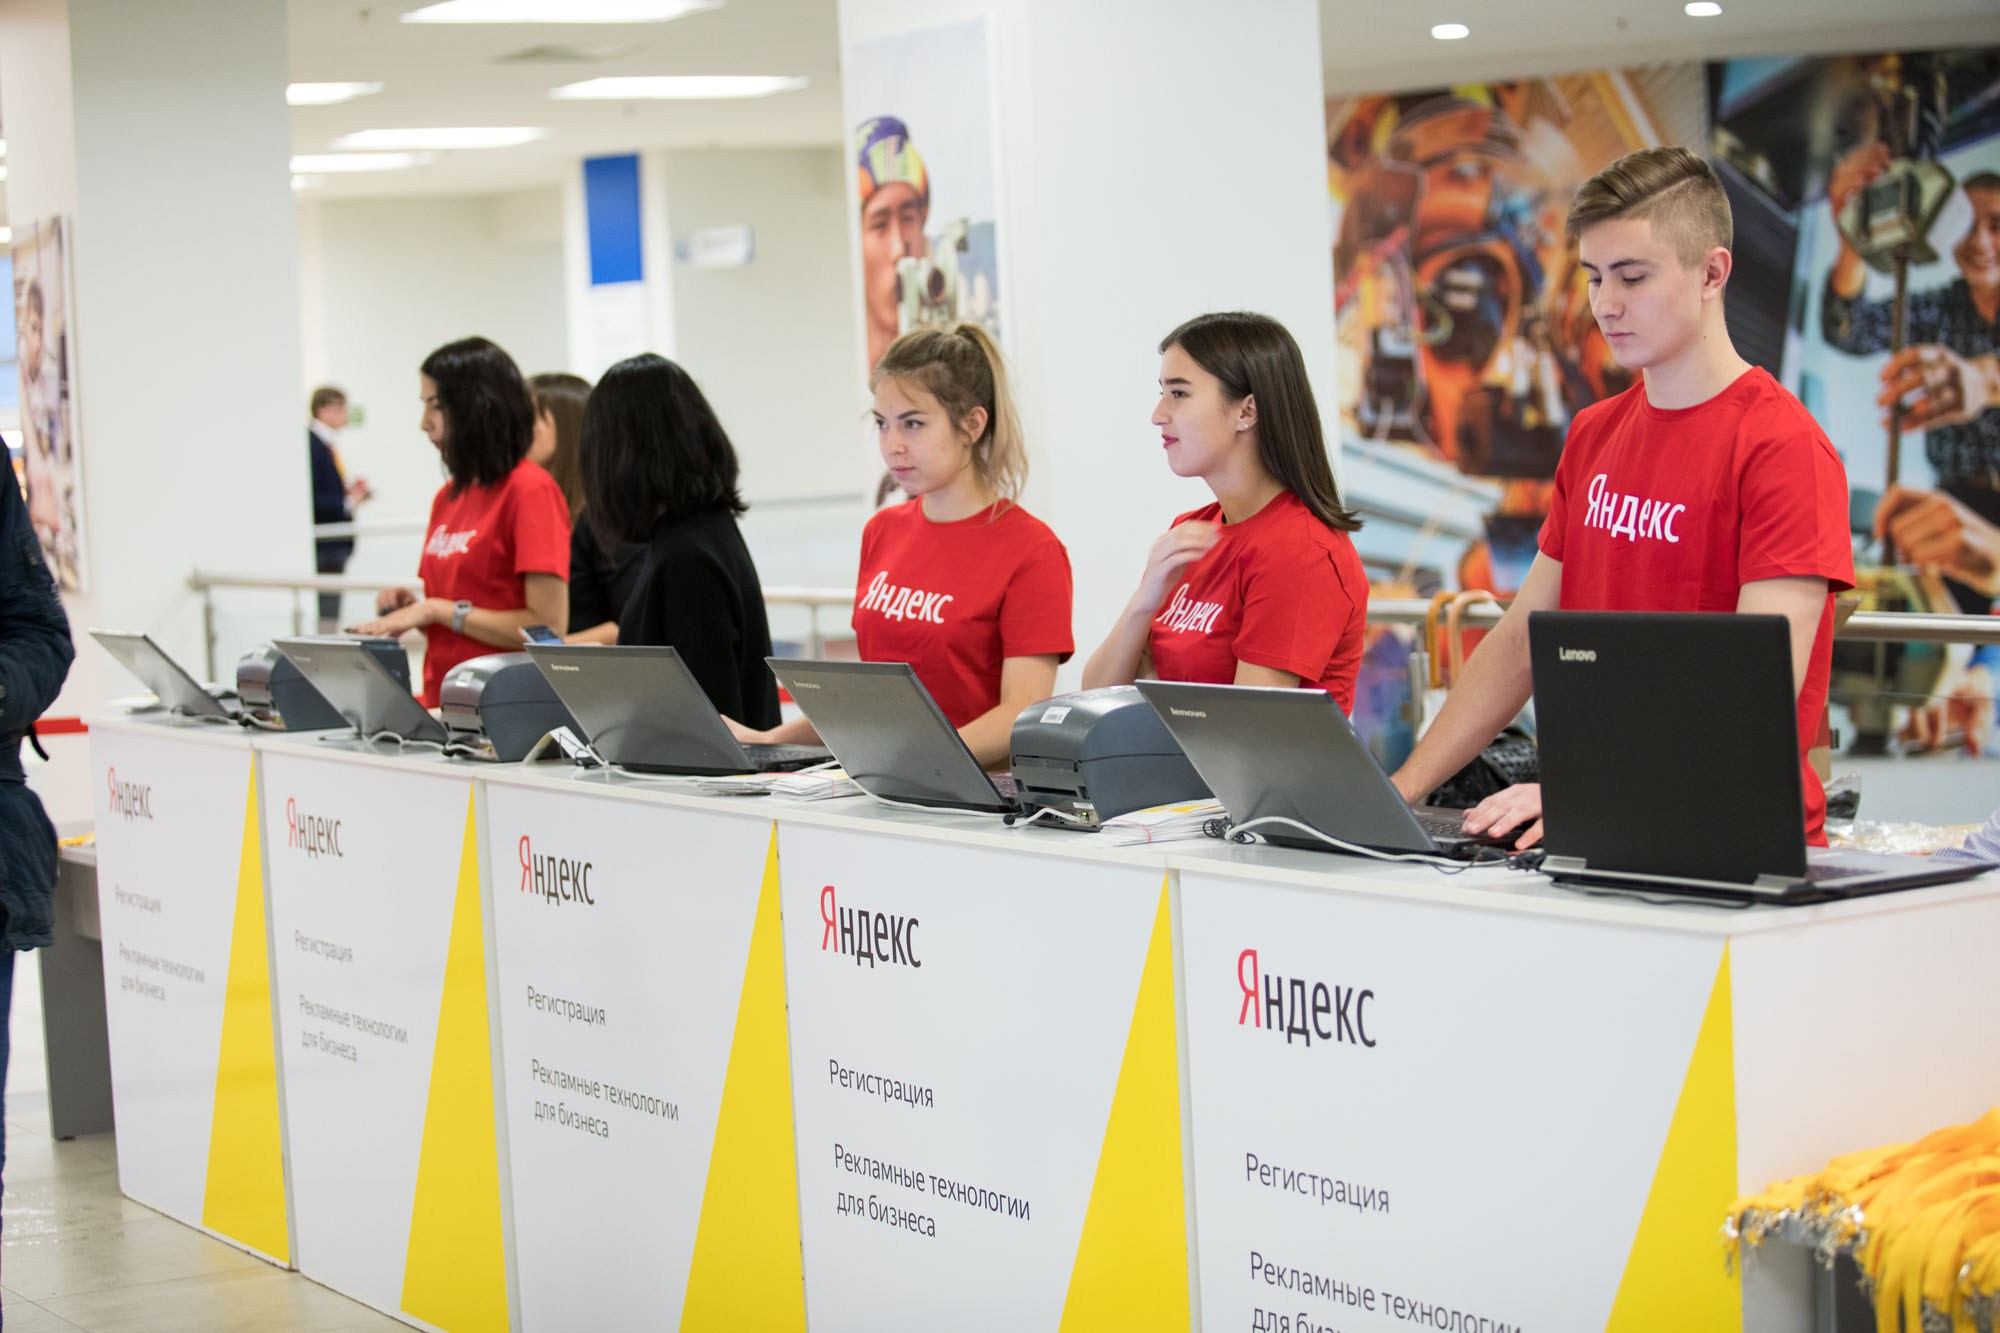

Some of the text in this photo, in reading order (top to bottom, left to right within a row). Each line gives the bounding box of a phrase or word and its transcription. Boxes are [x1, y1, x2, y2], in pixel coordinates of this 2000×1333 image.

[1583, 473, 1686, 543] Яндекс
[859, 570, 954, 624] Яндекс
[1155, 582, 1224, 634] Яндекс
[1558, 646, 1597, 662] Lenovo
[107, 766, 154, 821] Яндекс
[286, 796, 344, 859] Яндекс
[518, 834, 595, 907] Яндекс
[294, 928, 354, 964] Регистрация
[820, 885, 922, 969] Яндекс
[298, 993, 409, 1045] Рекламные технологии
[527, 985, 606, 1027] Регистрация
[1237, 948, 1377, 1049] Яндекс
[319, 1030, 358, 1063] бизнеса
[531, 1058, 680, 1122] Рекламные технологии
[829, 1058, 935, 1109] Регистрация
[534, 1100, 609, 1139] для бизнеса
[834, 1143, 1031, 1222] Рекламные технологии
[1246, 1151, 1391, 1214] Регистрация
[836, 1191, 936, 1238] для бизнеса
[1250, 1250, 1376, 1312] Рекламные
[1251, 1307, 1290, 1333] для
